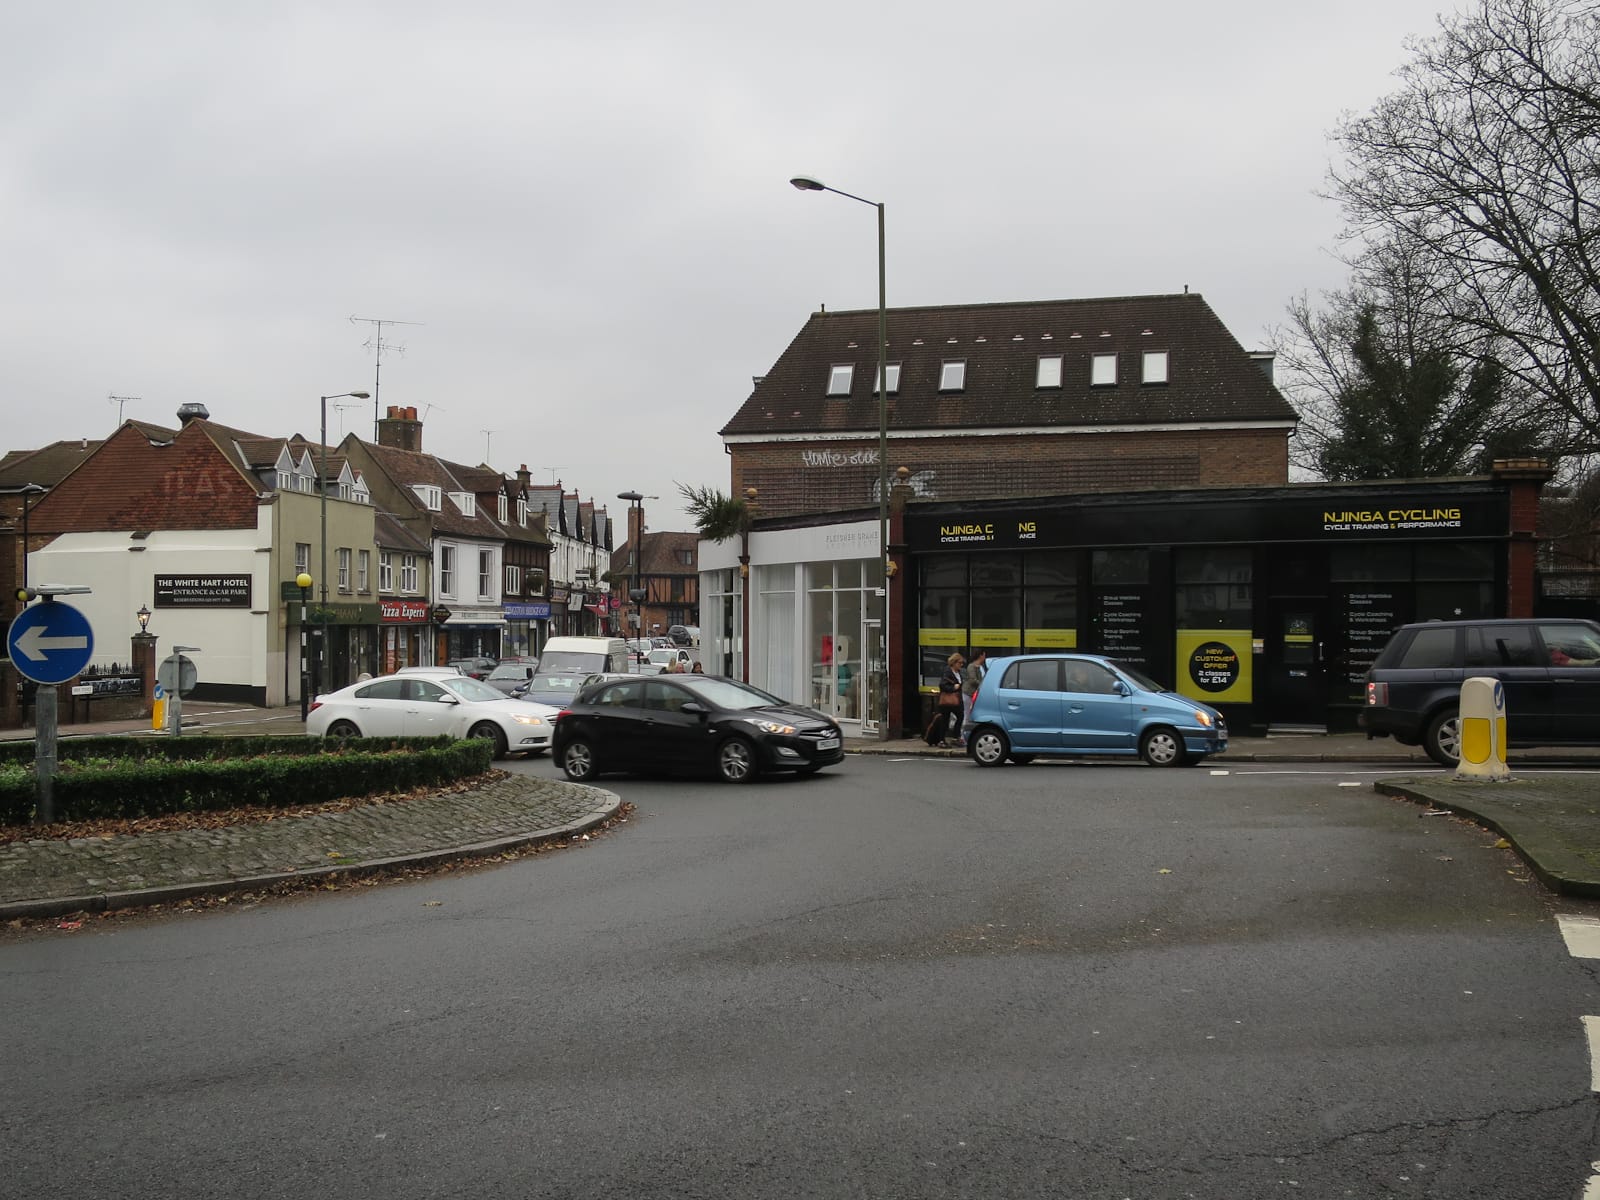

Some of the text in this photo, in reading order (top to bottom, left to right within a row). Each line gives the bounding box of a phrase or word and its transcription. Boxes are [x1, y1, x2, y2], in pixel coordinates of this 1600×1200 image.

[1324, 508, 1462, 522] NJINGA CYCLING
[1397, 521, 1462, 529] PERFORMANCE
[941, 525, 982, 535] NJINGA
[158, 579, 249, 587] THE WHITE HART HOTEL
[401, 604, 425, 620] Experts
[1211, 676, 1228, 684] £14
